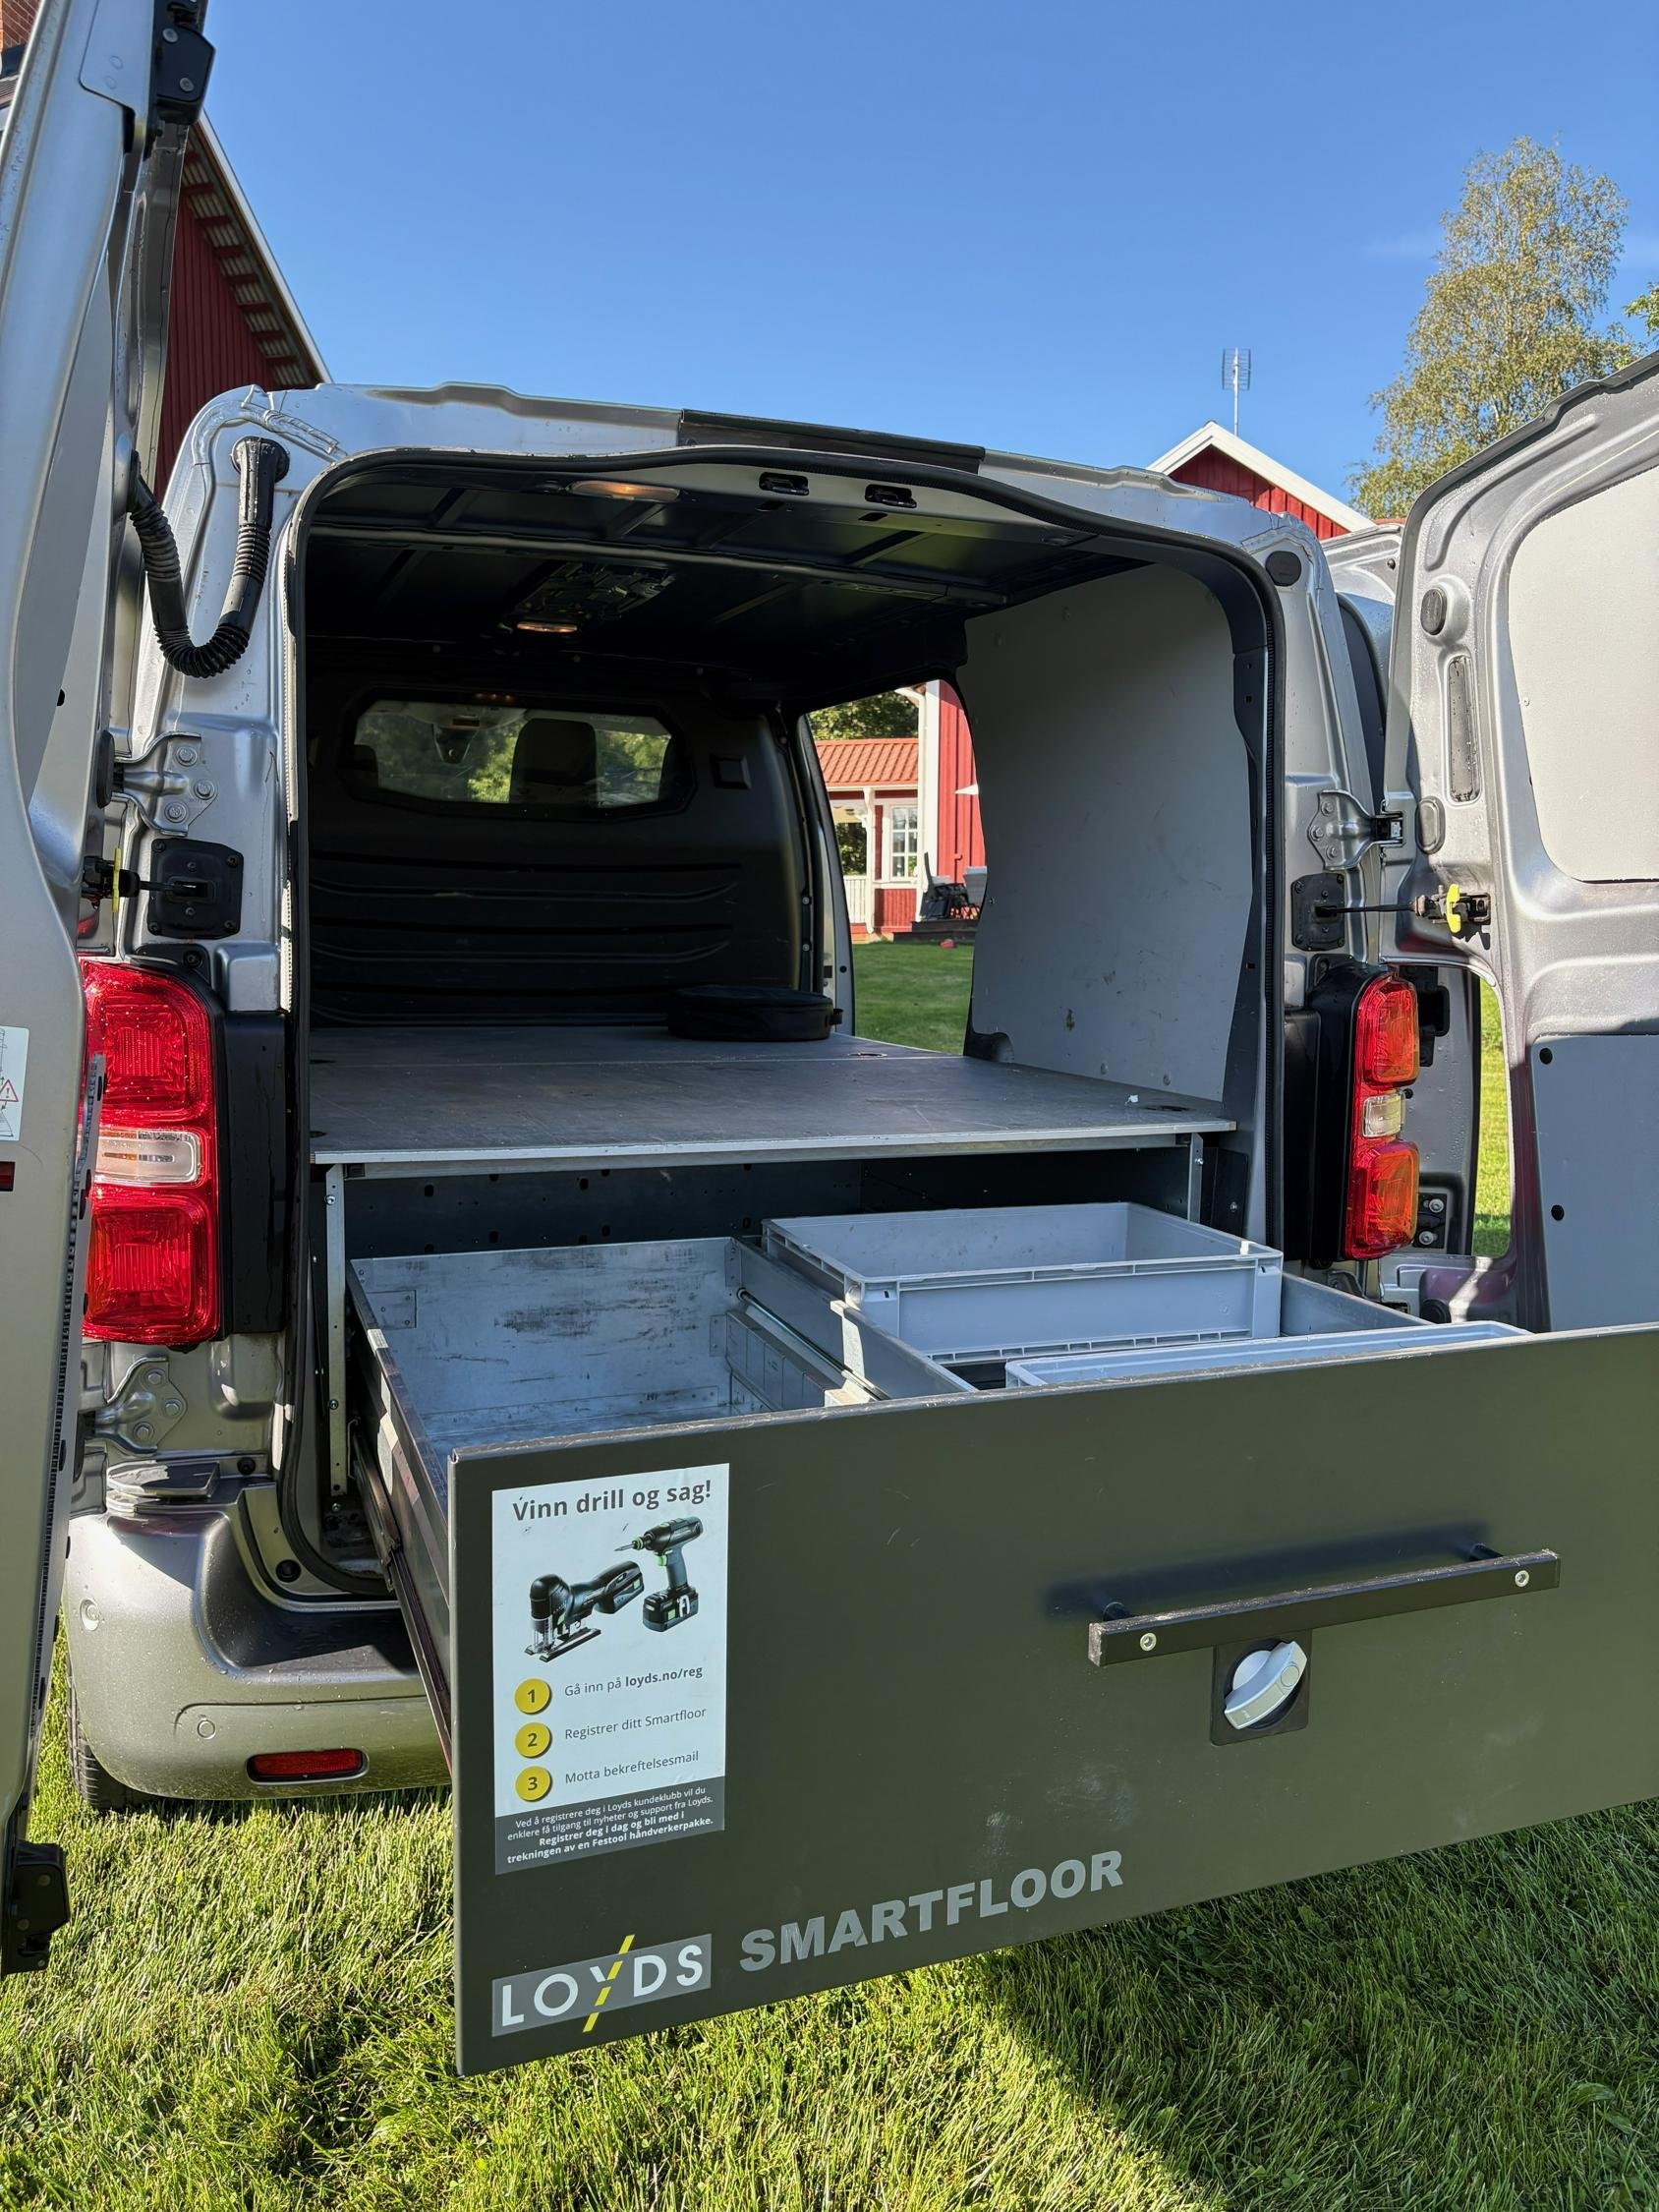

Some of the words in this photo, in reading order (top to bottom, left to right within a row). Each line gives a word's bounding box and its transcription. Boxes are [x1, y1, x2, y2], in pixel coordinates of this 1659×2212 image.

[512, 1499, 568, 1522] Vinn
[576, 1488, 624, 1514] drill
[632, 1489, 659, 1510] og
[666, 1480, 712, 1504] sag!
[528, 1689, 536, 1703] 1
[564, 1683, 581, 1697] Gå
[584, 1682, 603, 1694] inn
[607, 1677, 622, 1693] på
[625, 1666, 703, 1689] loyds.no/reg
[527, 1732, 538, 1747] 2
[565, 1721, 618, 1740] Registrer
[621, 1716, 643, 1730] ditt
[645, 1708, 707, 1727] Smartfloor
[527, 1776, 538, 1791] 3
[565, 1769, 601, 1784] Motta
[604, 1750, 699, 1777] bekreftelsesmail
[507, 1829, 540, 1840] enklere
[542, 1825, 550, 1834] få
[552, 1821, 581, 1833] tilgang
[583, 1818, 592, 1827] til
[594, 1812, 626, 1826] nyheter
[628, 1810, 639, 1819] og
[640, 1803, 672, 1816] support
[674, 1800, 686, 1809] fra
[688, 1795, 713, 1807] Loyds.
[515, 1817, 532, 1829] Ved
[534, 1816, 540, 1825] å
[542, 1810, 583, 1824] registrere
[585, 1806, 601, 1816] deg
[607, 1800, 632, 1812] Loyds
[634, 1790, 682, 1806] kundeklubb
[683, 1787, 693, 1797] vil
[695, 1786, 706, 1795] du
[539, 1831, 584, 1846] Registrer
[586, 1828, 603, 1837] deg
[611, 1823, 629, 1833] dag
[630, 1820, 642, 1830] og
[644, 1816, 657, 1826] bli
[658, 1811, 679, 1824] med
[507, 1846, 561, 1864] trekningen
[592, 1833, 627, 1847] Festool
[629, 1818, 714, 1840] håndverkerpakke.
[502, 1942, 703, 2028] LOYDS
[739, 1849, 1123, 1973] SMARTFLOOR
